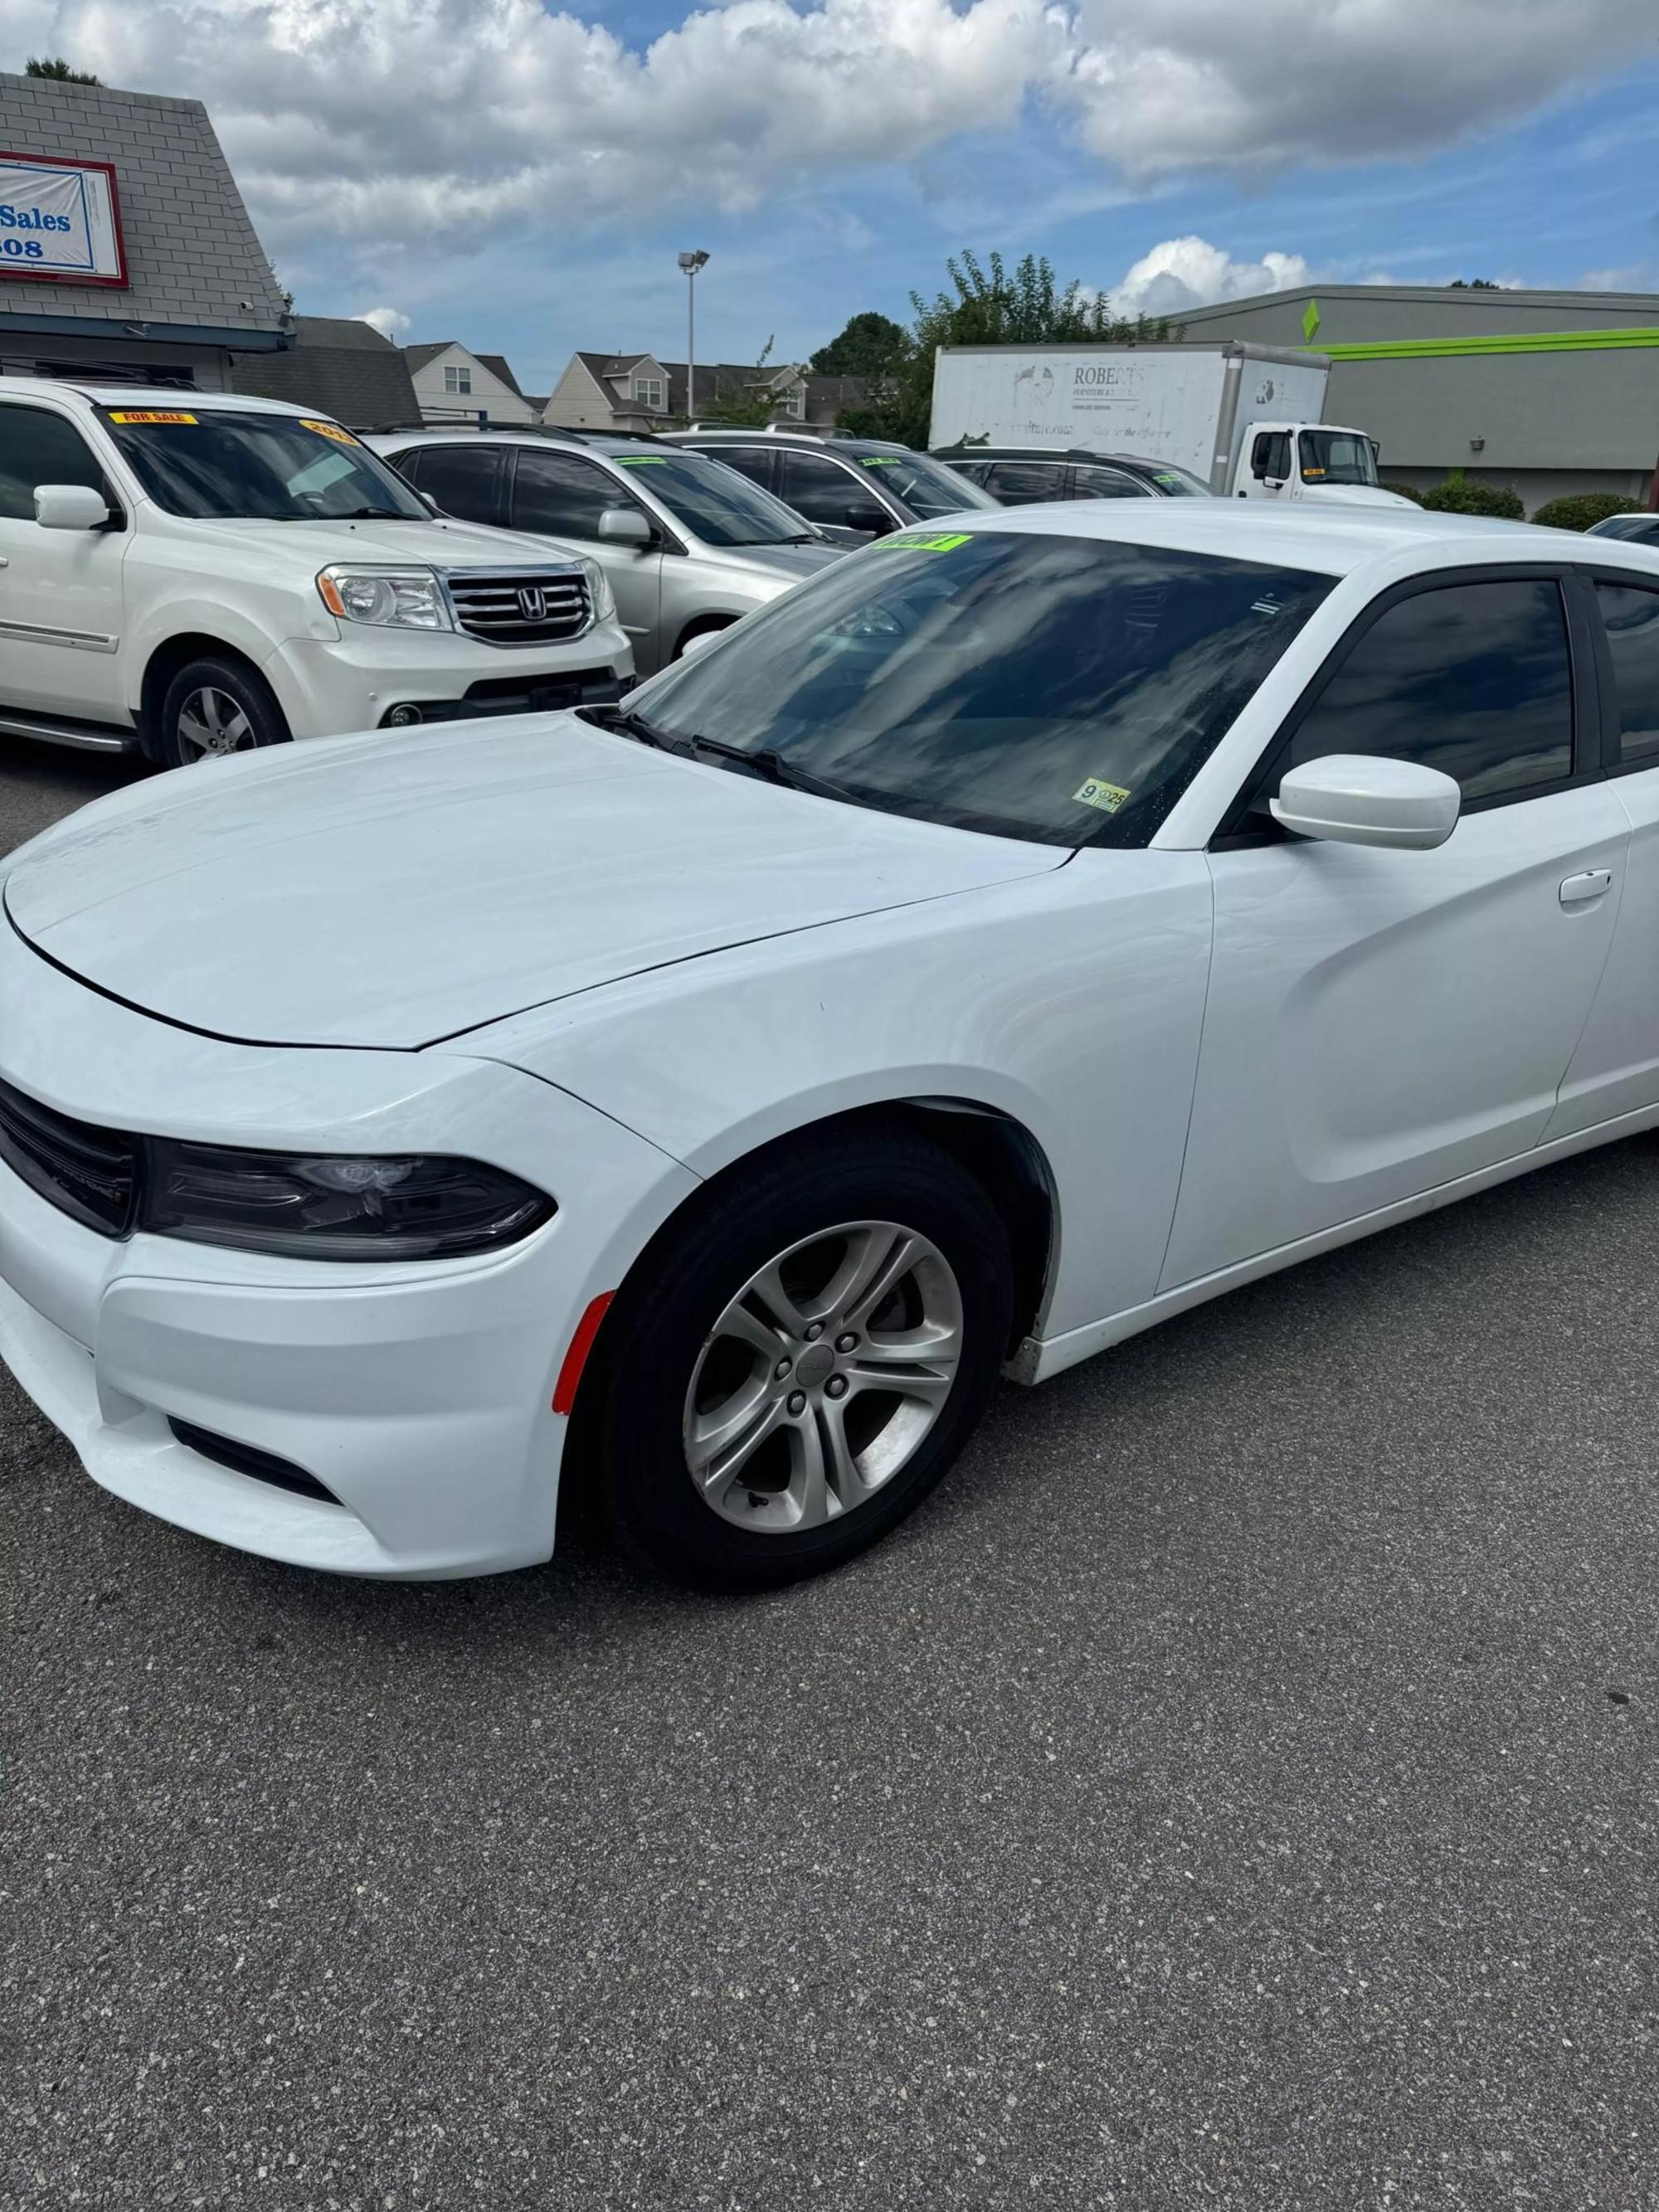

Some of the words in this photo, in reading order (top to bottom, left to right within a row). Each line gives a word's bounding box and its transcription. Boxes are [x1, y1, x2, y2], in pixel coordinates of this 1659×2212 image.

[0, 205, 71, 231] Sales
[0, 238, 43, 258] 08
[122, 413, 150, 421] FOR
[153, 414, 187, 422] SALE
[1081, 785, 1097, 798] 9
[1107, 792, 1126, 805] 25
